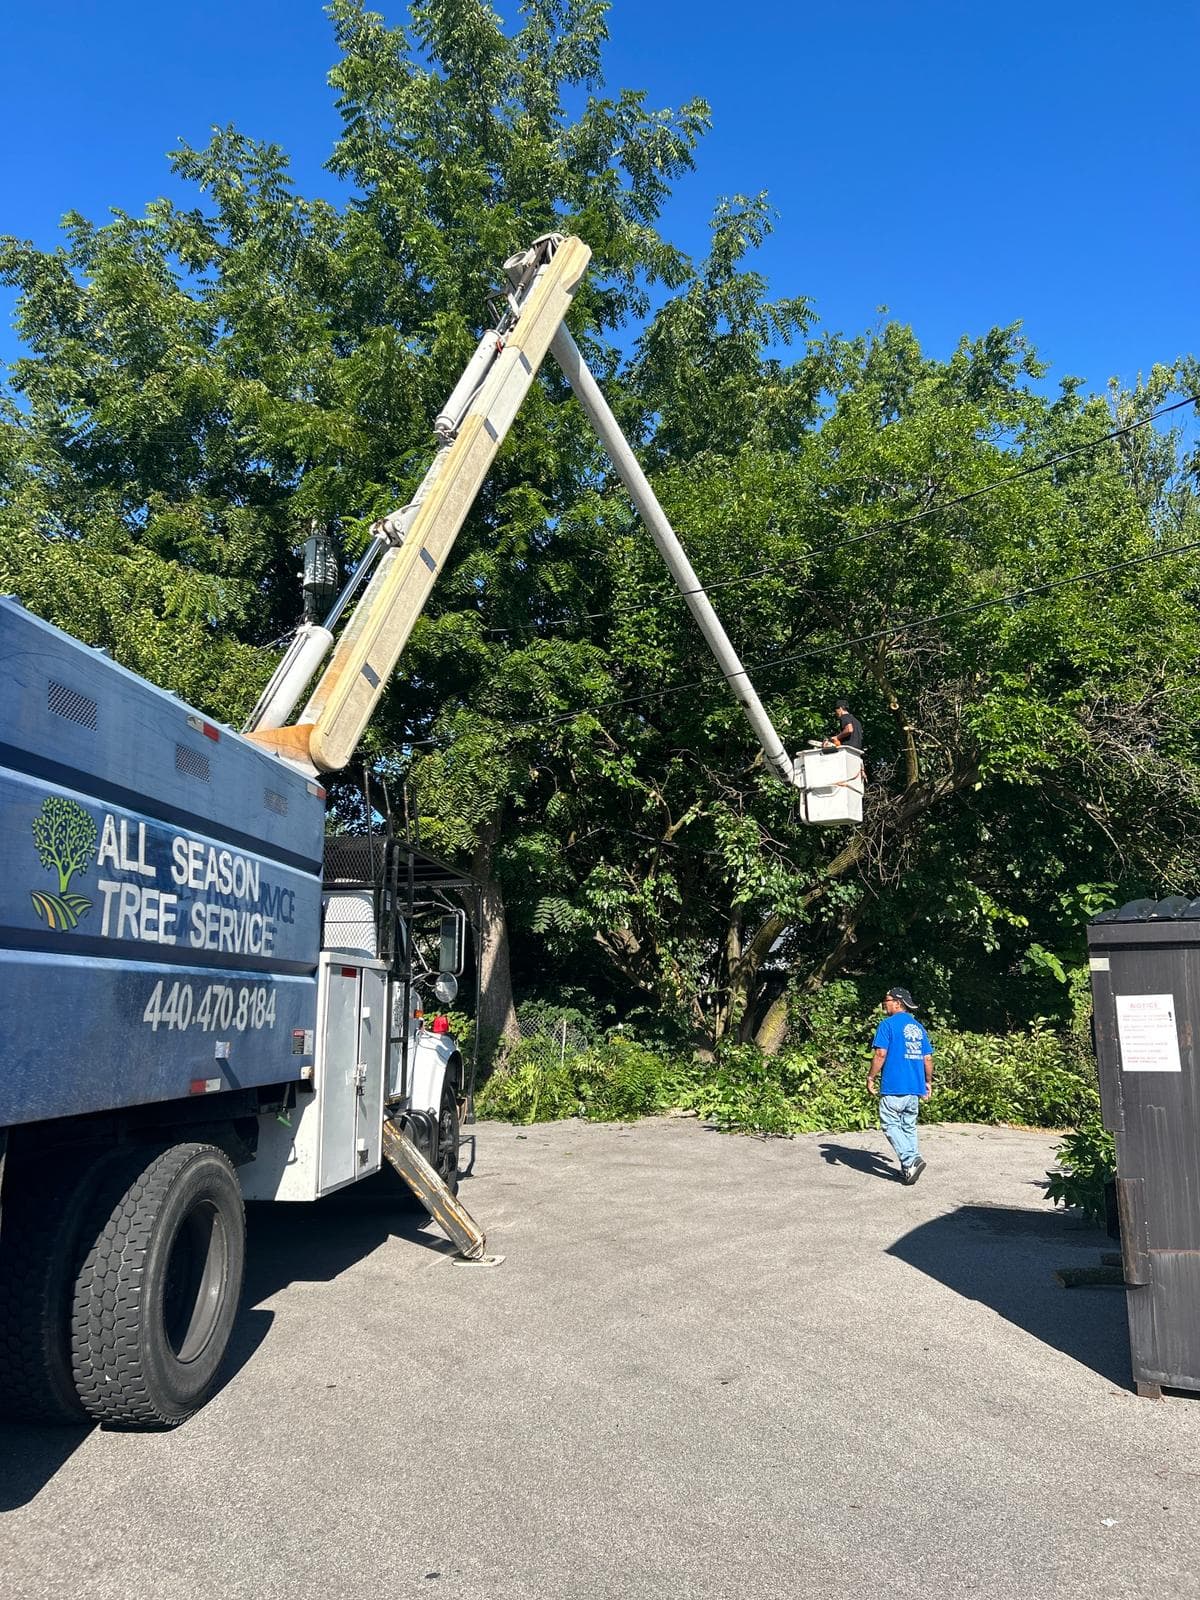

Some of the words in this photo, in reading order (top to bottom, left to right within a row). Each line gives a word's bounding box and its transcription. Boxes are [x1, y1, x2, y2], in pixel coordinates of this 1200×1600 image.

[97, 814, 156, 877] ALL
[171, 836, 259, 902] SEASON
[97, 880, 178, 946] TREE
[190, 902, 274, 957] SERVICE
[143, 980, 277, 1032] 440.470.8184
